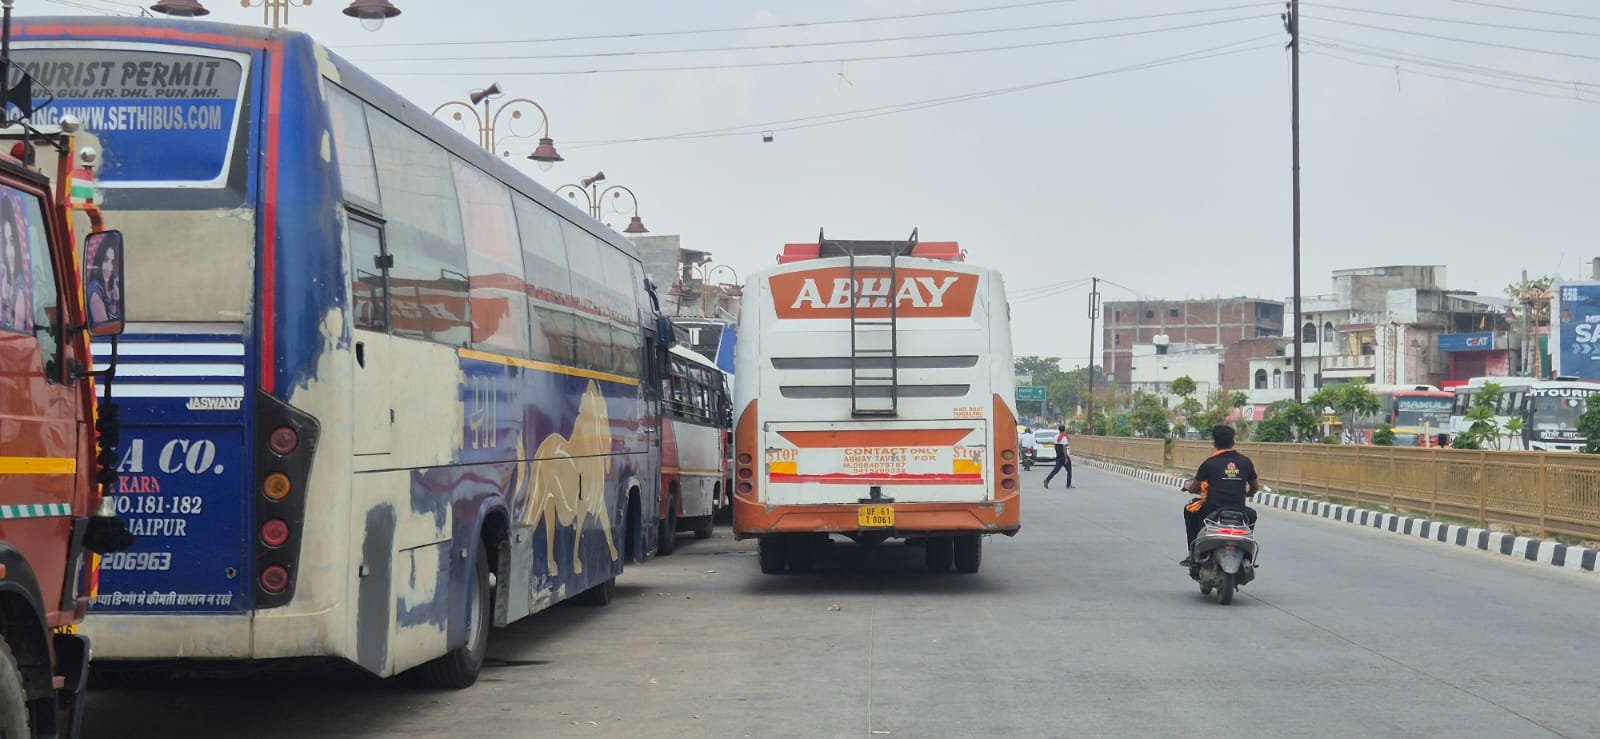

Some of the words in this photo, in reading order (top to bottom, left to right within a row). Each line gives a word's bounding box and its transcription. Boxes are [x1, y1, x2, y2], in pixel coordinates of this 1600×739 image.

[9, 61, 115, 88] TOURIST
[120, 61, 221, 88] PERMIT
[791, 276, 959, 309] ABHAY
[1465, 336, 1489, 347] CEAT
[185, 397, 243, 410] JASWANT
[158, 438, 224, 475] CO.
[844, 447, 907, 455] CONTACT
[910, 447, 939, 455] ONLY
[128, 518, 187, 537] JAIPUR
